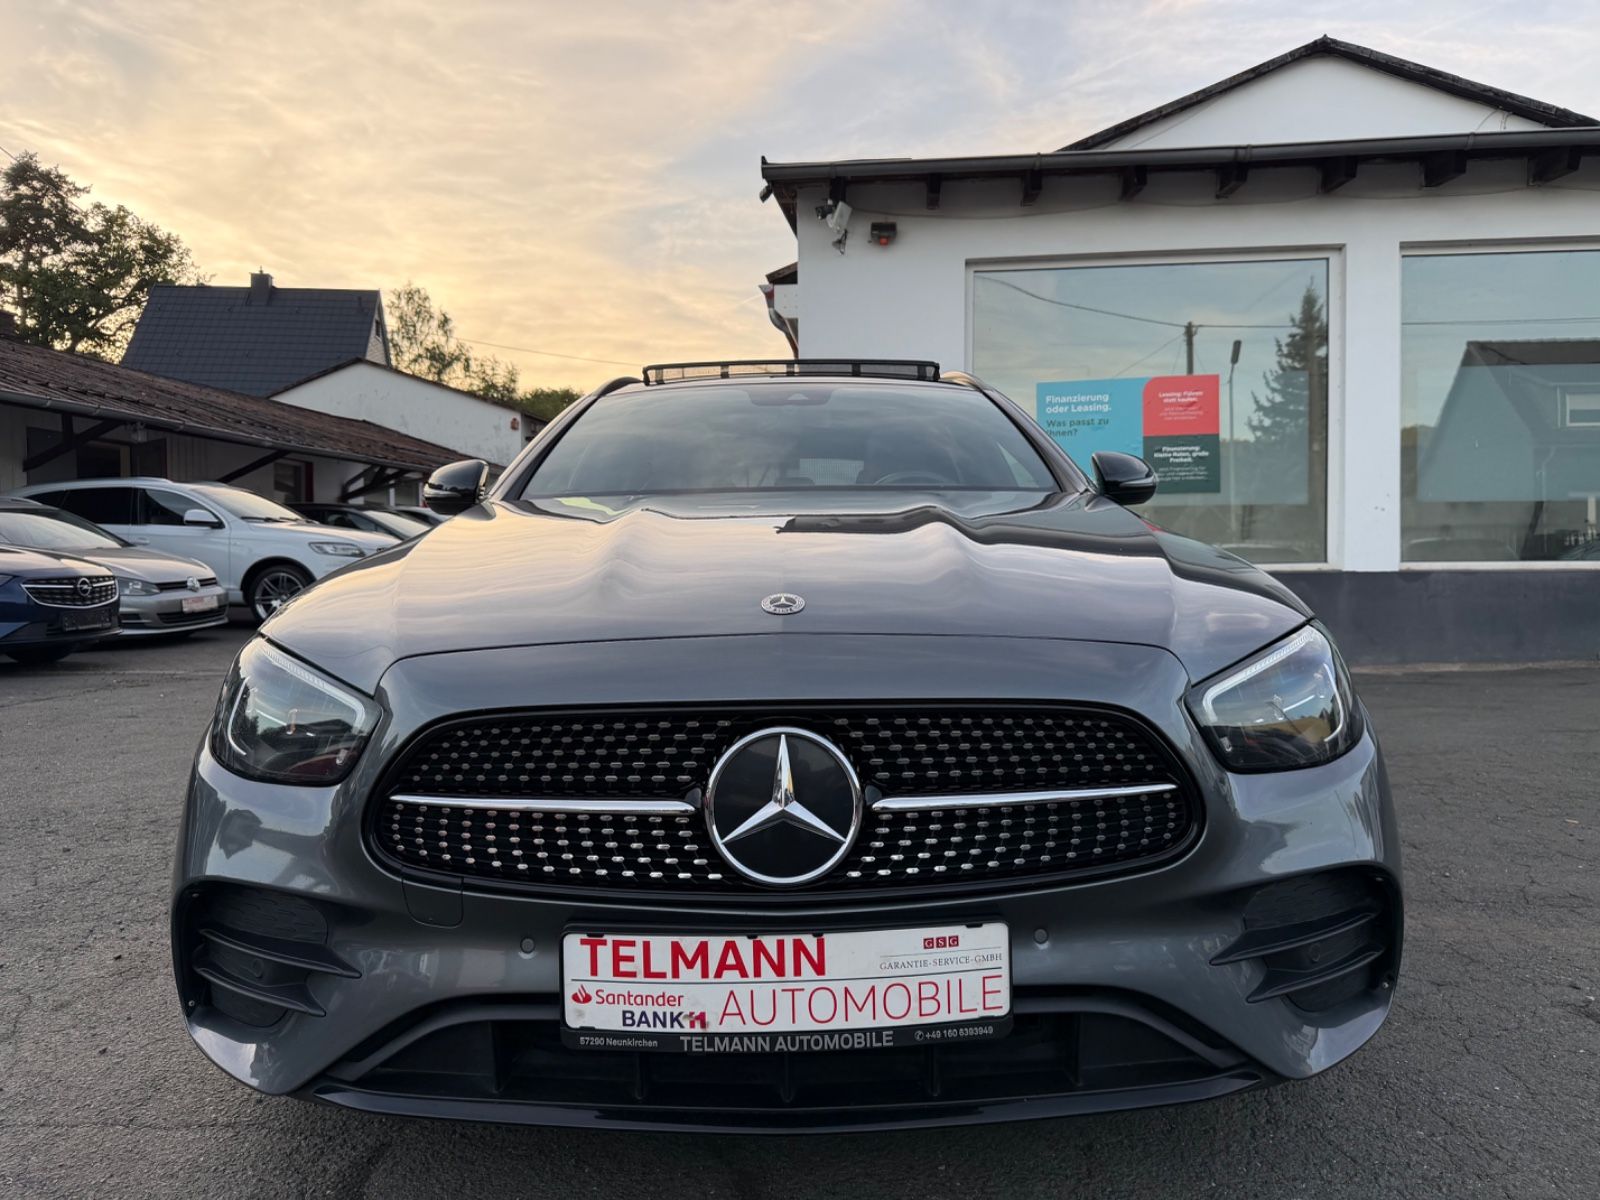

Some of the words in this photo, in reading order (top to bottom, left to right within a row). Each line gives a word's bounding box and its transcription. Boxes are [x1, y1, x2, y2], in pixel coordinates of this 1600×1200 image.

[1046, 394, 1109, 404] Finanzierung
[1046, 405, 1069, 414] oder
[1071, 404, 1112, 412] Leasing.
[1047, 419, 1067, 428] Was
[1069, 418, 1095, 428] passt
[1097, 418, 1109, 426] zu
[924, 935, 959, 949] GSG
[580, 938, 826, 979] TELMANN
[595, 989, 684, 1007] Santander
[719, 974, 1003, 1026] AUTOMOBILE
[606, 1037, 658, 1048] Neunkirchen
[680, 1036, 770, 1053] TELMANN
[775, 1031, 894, 1051] AUTOMOBILE
